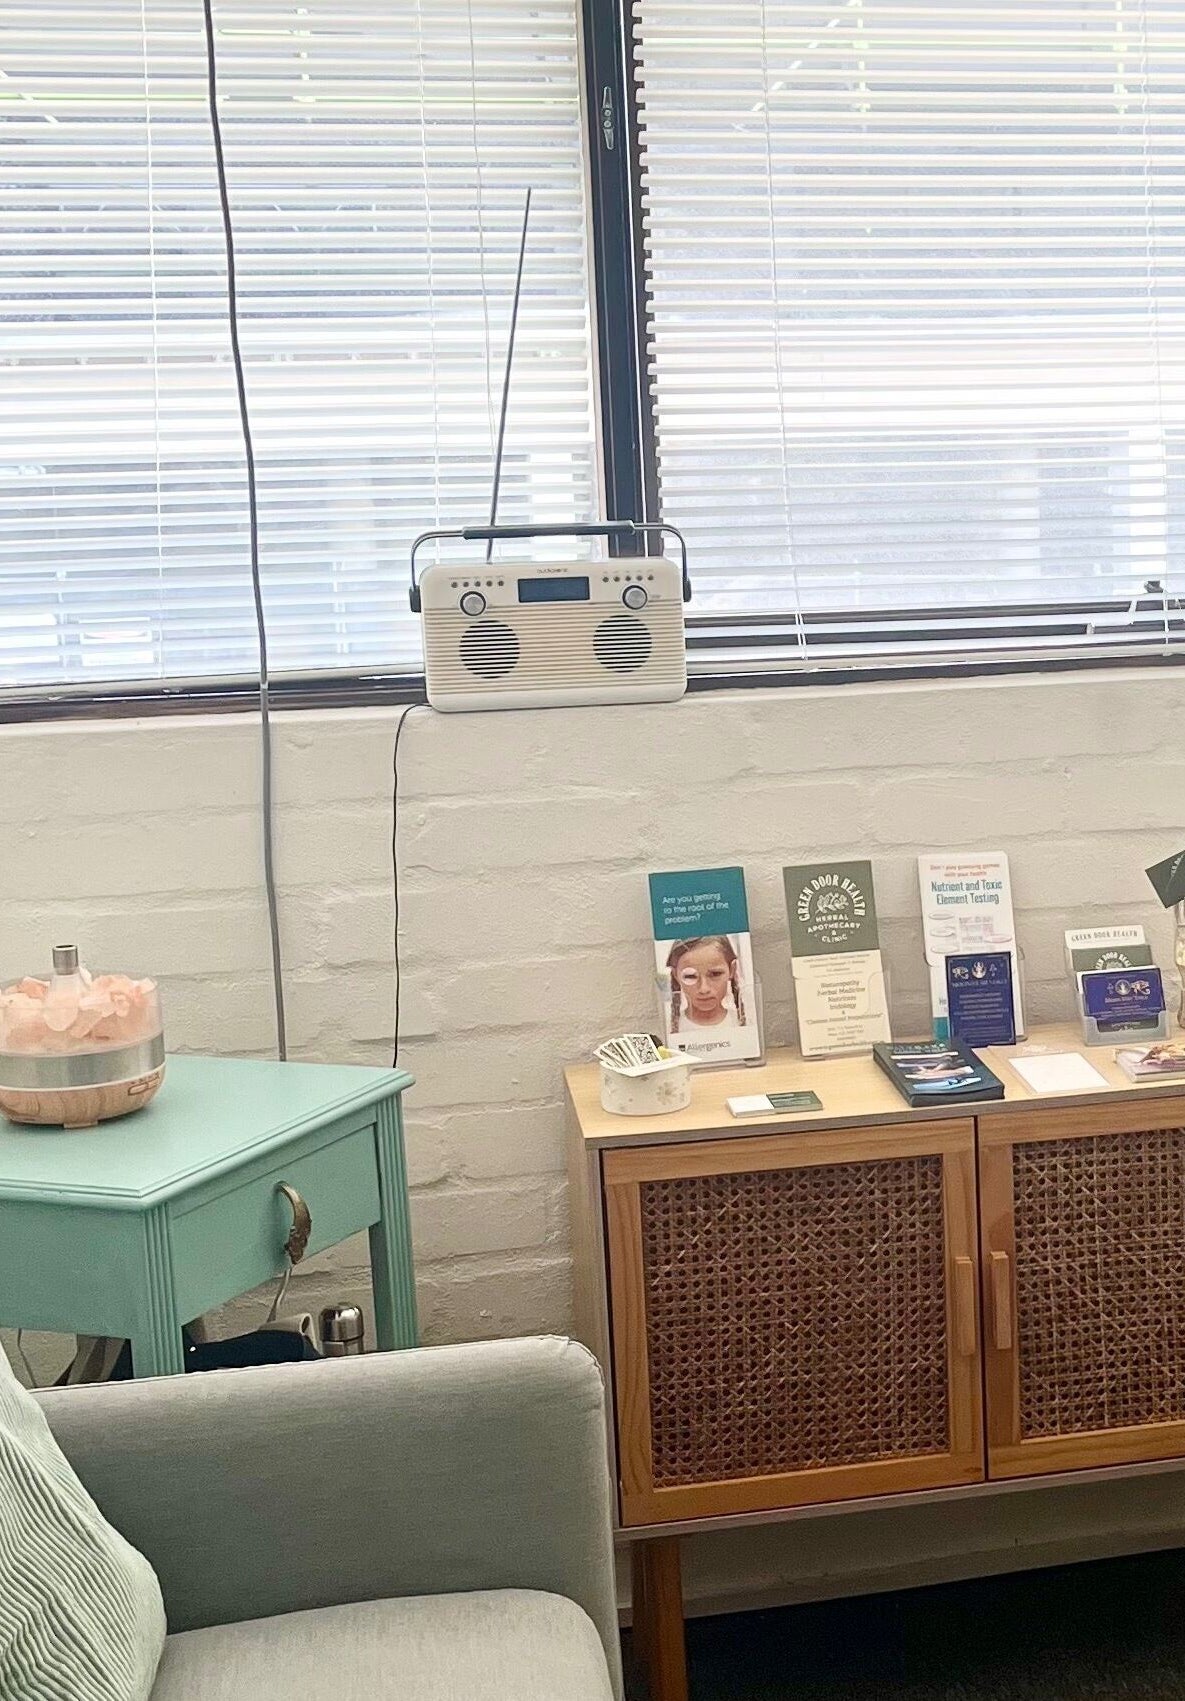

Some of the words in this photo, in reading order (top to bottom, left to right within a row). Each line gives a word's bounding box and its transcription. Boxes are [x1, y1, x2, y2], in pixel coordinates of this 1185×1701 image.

[931, 881, 965, 892] Nutrient
[966, 880, 980, 891] and
[981, 879, 1003, 890] Toxic
[662, 896, 676, 904] Are
[677, 896, 692, 905] you
[693, 893, 721, 903] getting
[798, 886, 814, 922] GREEN
[811, 874, 839, 890] DOOR
[840, 877, 866, 917] HEALTH
[936, 893, 968, 905] Element
[970, 893, 1000, 905] Testing
[705, 902, 715, 910] of
[716, 902, 729, 910] the
[665, 912, 701, 925] problem?
[815, 914, 849, 923] HERBAL
[807, 922, 861, 933] APOTHECARY
[821, 933, 848, 943] CLINIC
